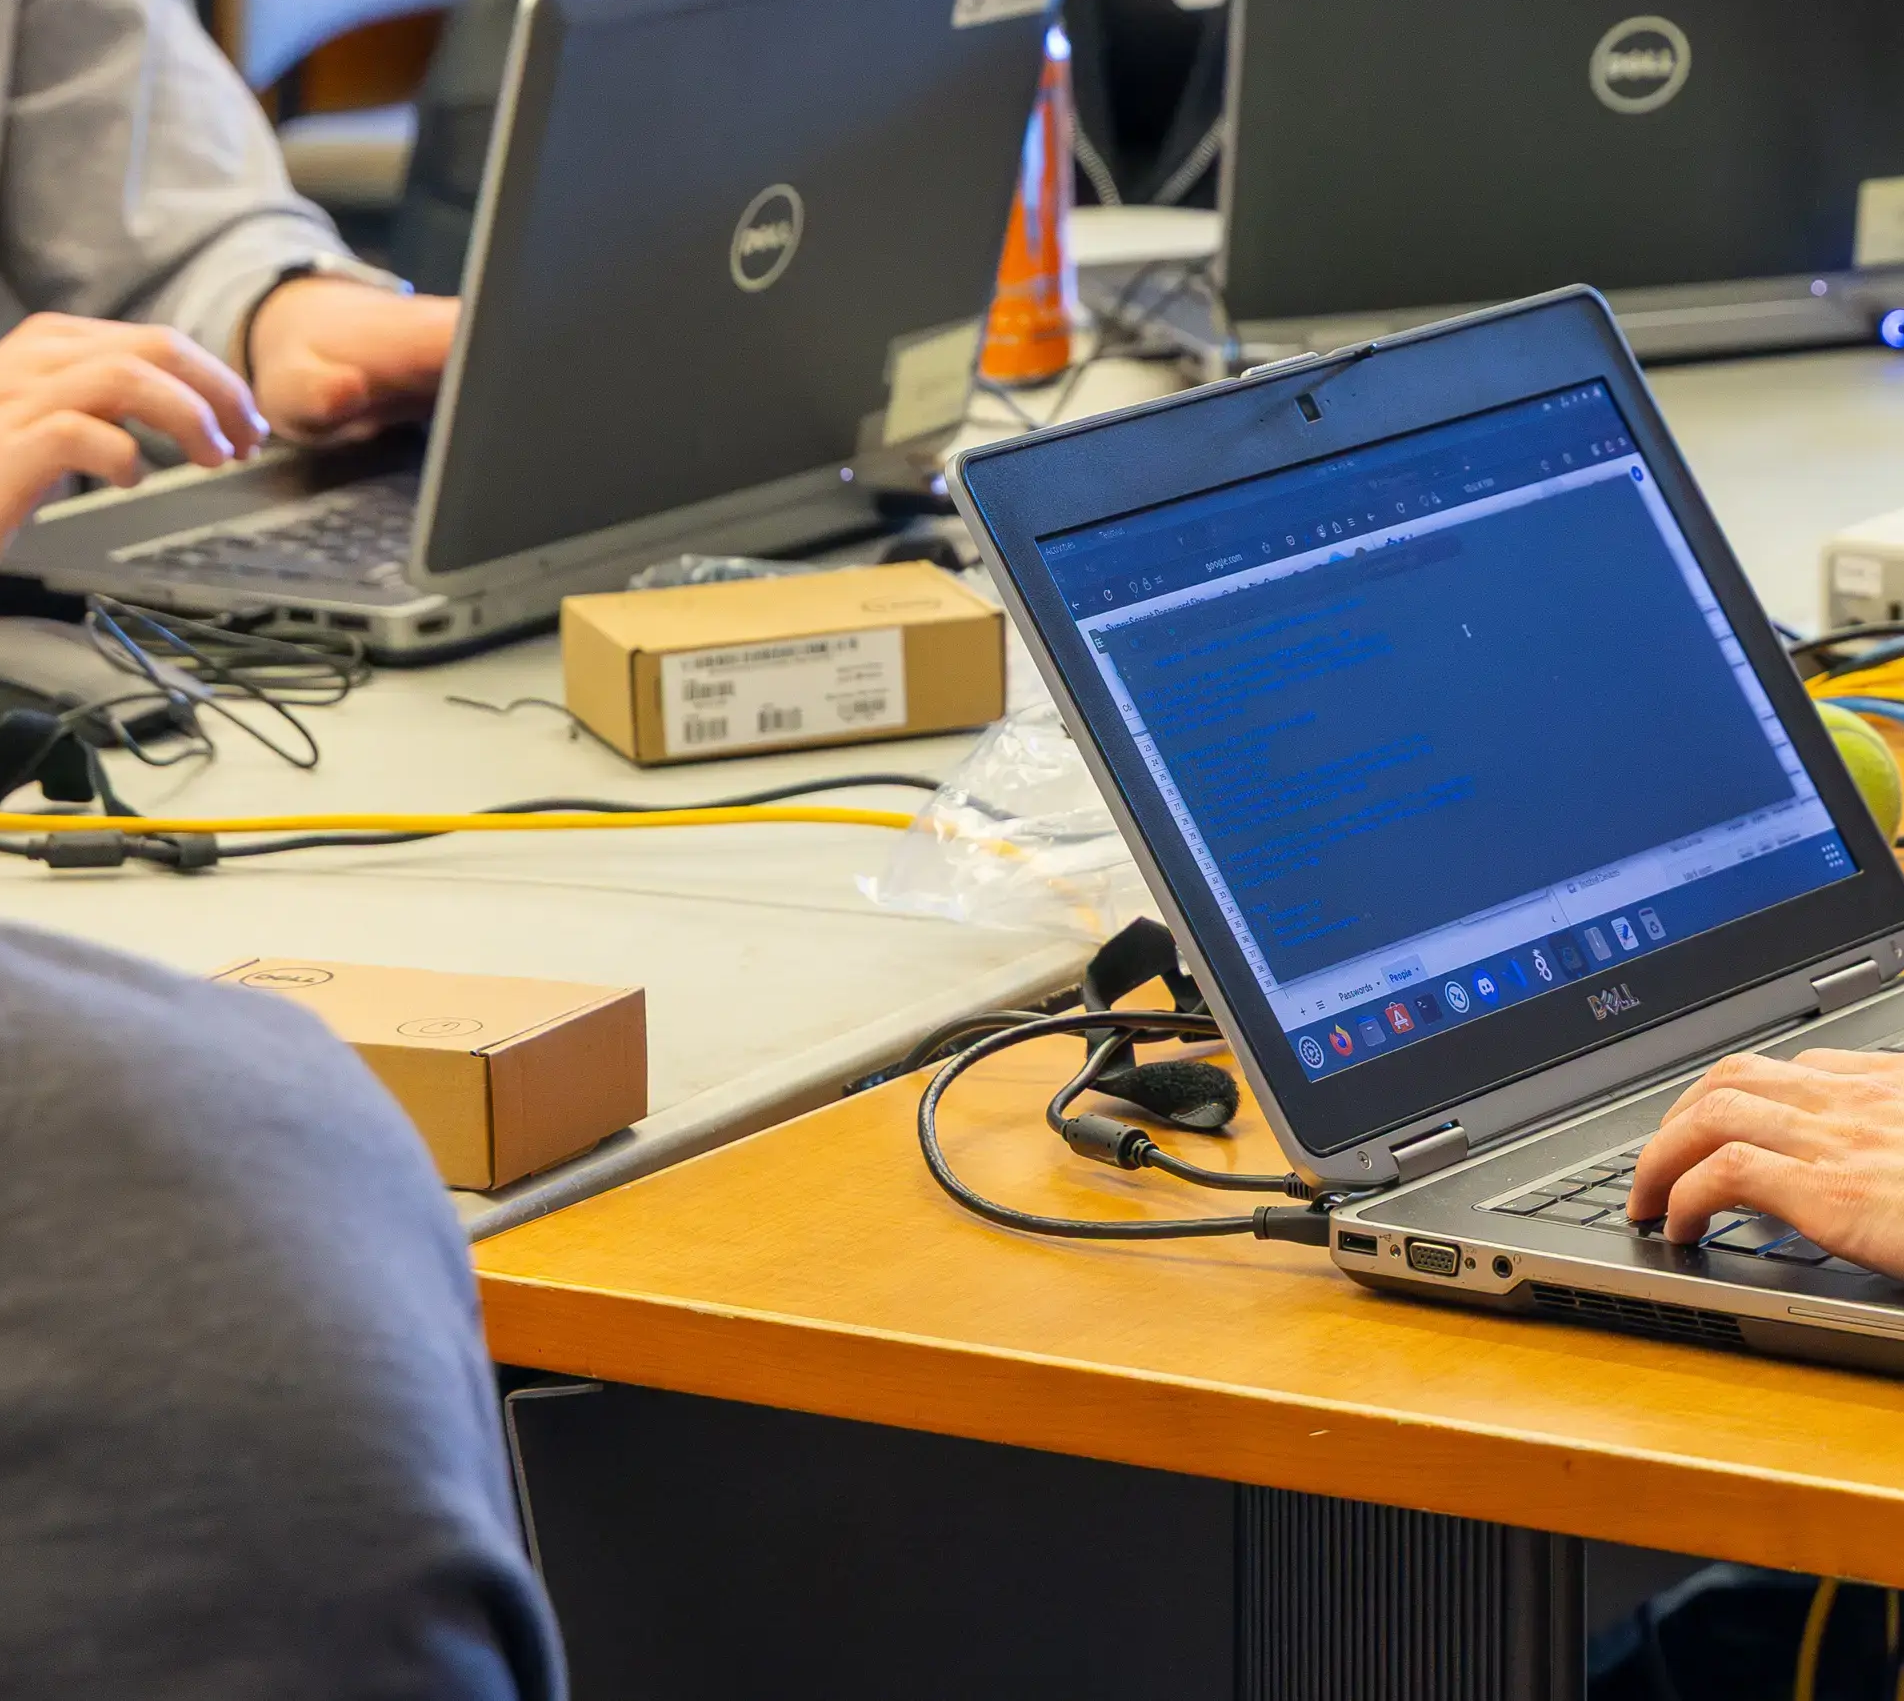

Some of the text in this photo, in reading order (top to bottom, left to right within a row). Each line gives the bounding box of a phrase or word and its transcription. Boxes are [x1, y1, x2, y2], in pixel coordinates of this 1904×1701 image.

[1604, 47, 1674, 82] DELL
[1044, 540, 1077, 556] Activities
[1204, 552, 1243, 573] google.com
[1338, 965, 1413, 1002] Passwords People
[1586, 983, 1641, 1020] DELL
